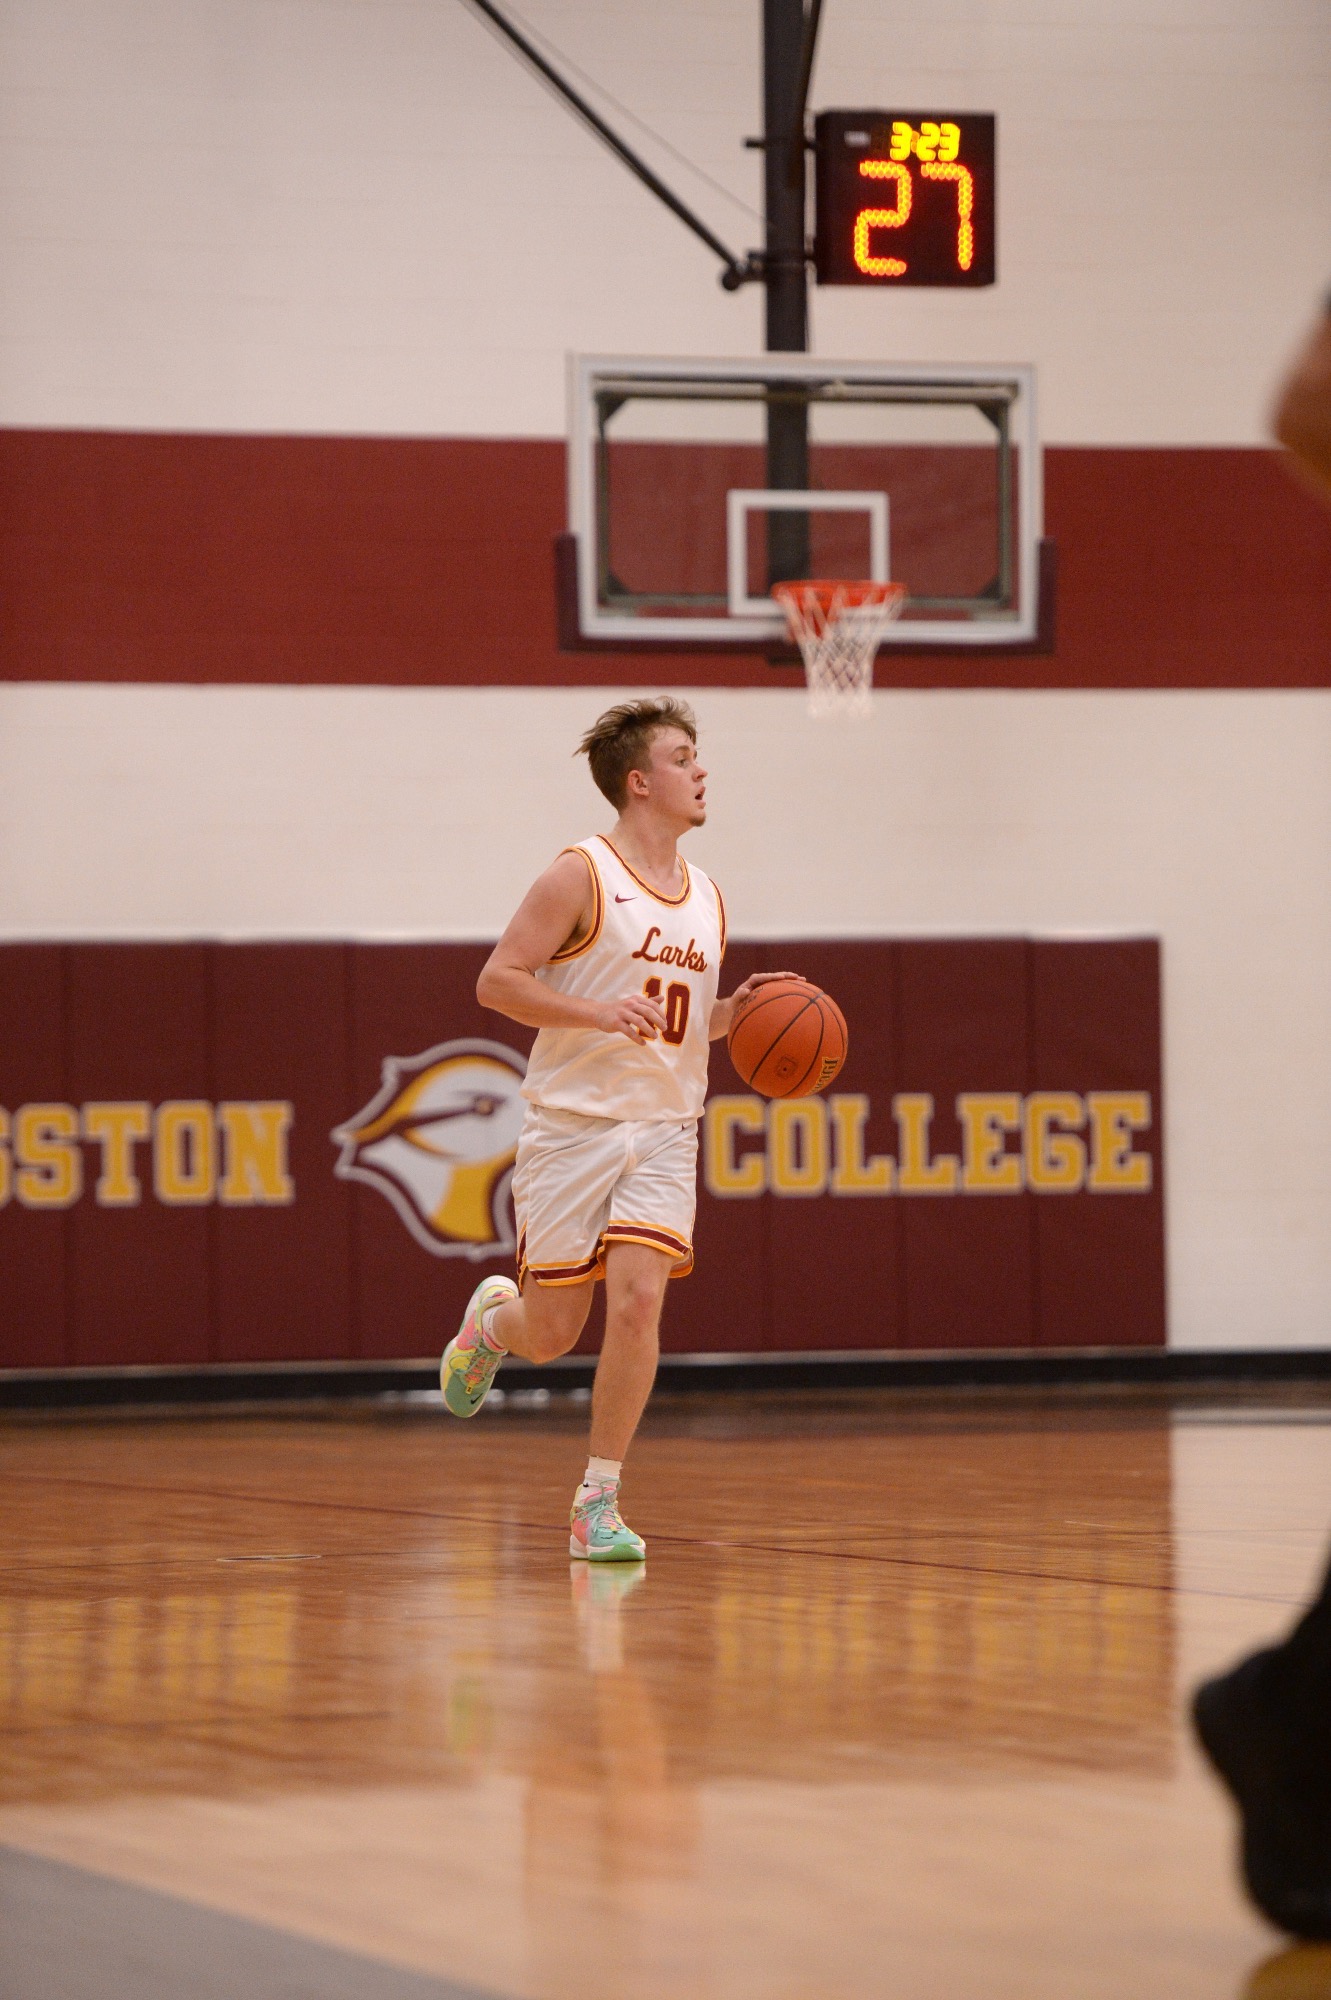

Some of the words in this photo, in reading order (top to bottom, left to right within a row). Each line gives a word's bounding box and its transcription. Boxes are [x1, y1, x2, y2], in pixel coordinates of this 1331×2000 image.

[890, 121, 961, 161] 3:23
[854, 160, 974, 277] 27
[631, 926, 708, 973] Larks
[0, 1101, 295, 1207] STON
[706, 1093, 1151, 1195] COLLEGE
